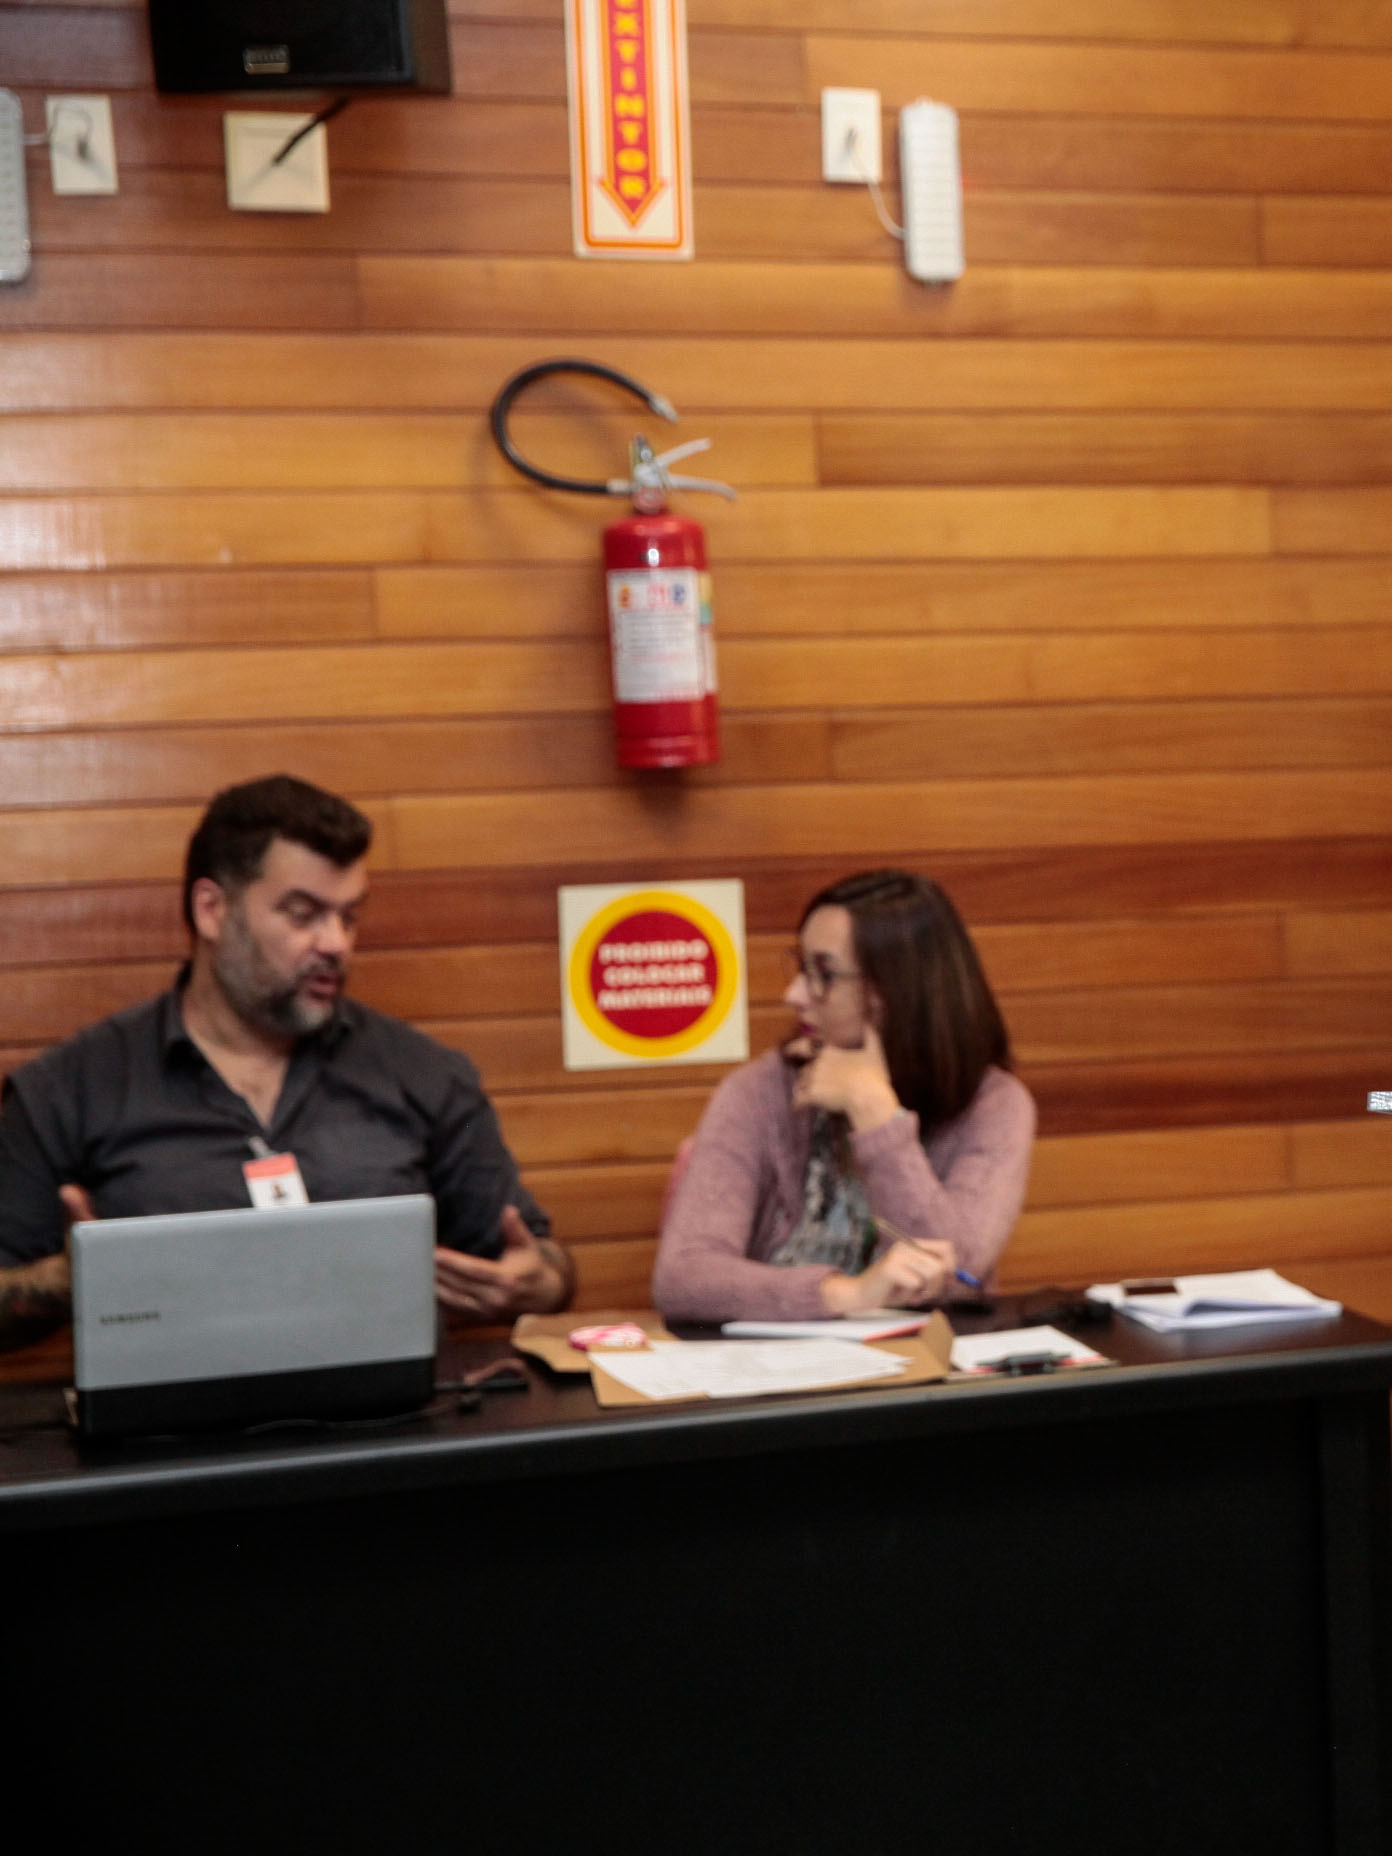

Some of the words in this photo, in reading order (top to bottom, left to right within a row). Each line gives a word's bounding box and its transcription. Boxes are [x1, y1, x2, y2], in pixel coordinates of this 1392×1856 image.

[599, 939, 709, 964] PROIBIDO
[603, 962, 706, 987] COLOCAR
[598, 984, 712, 1010] MATERIAIS
